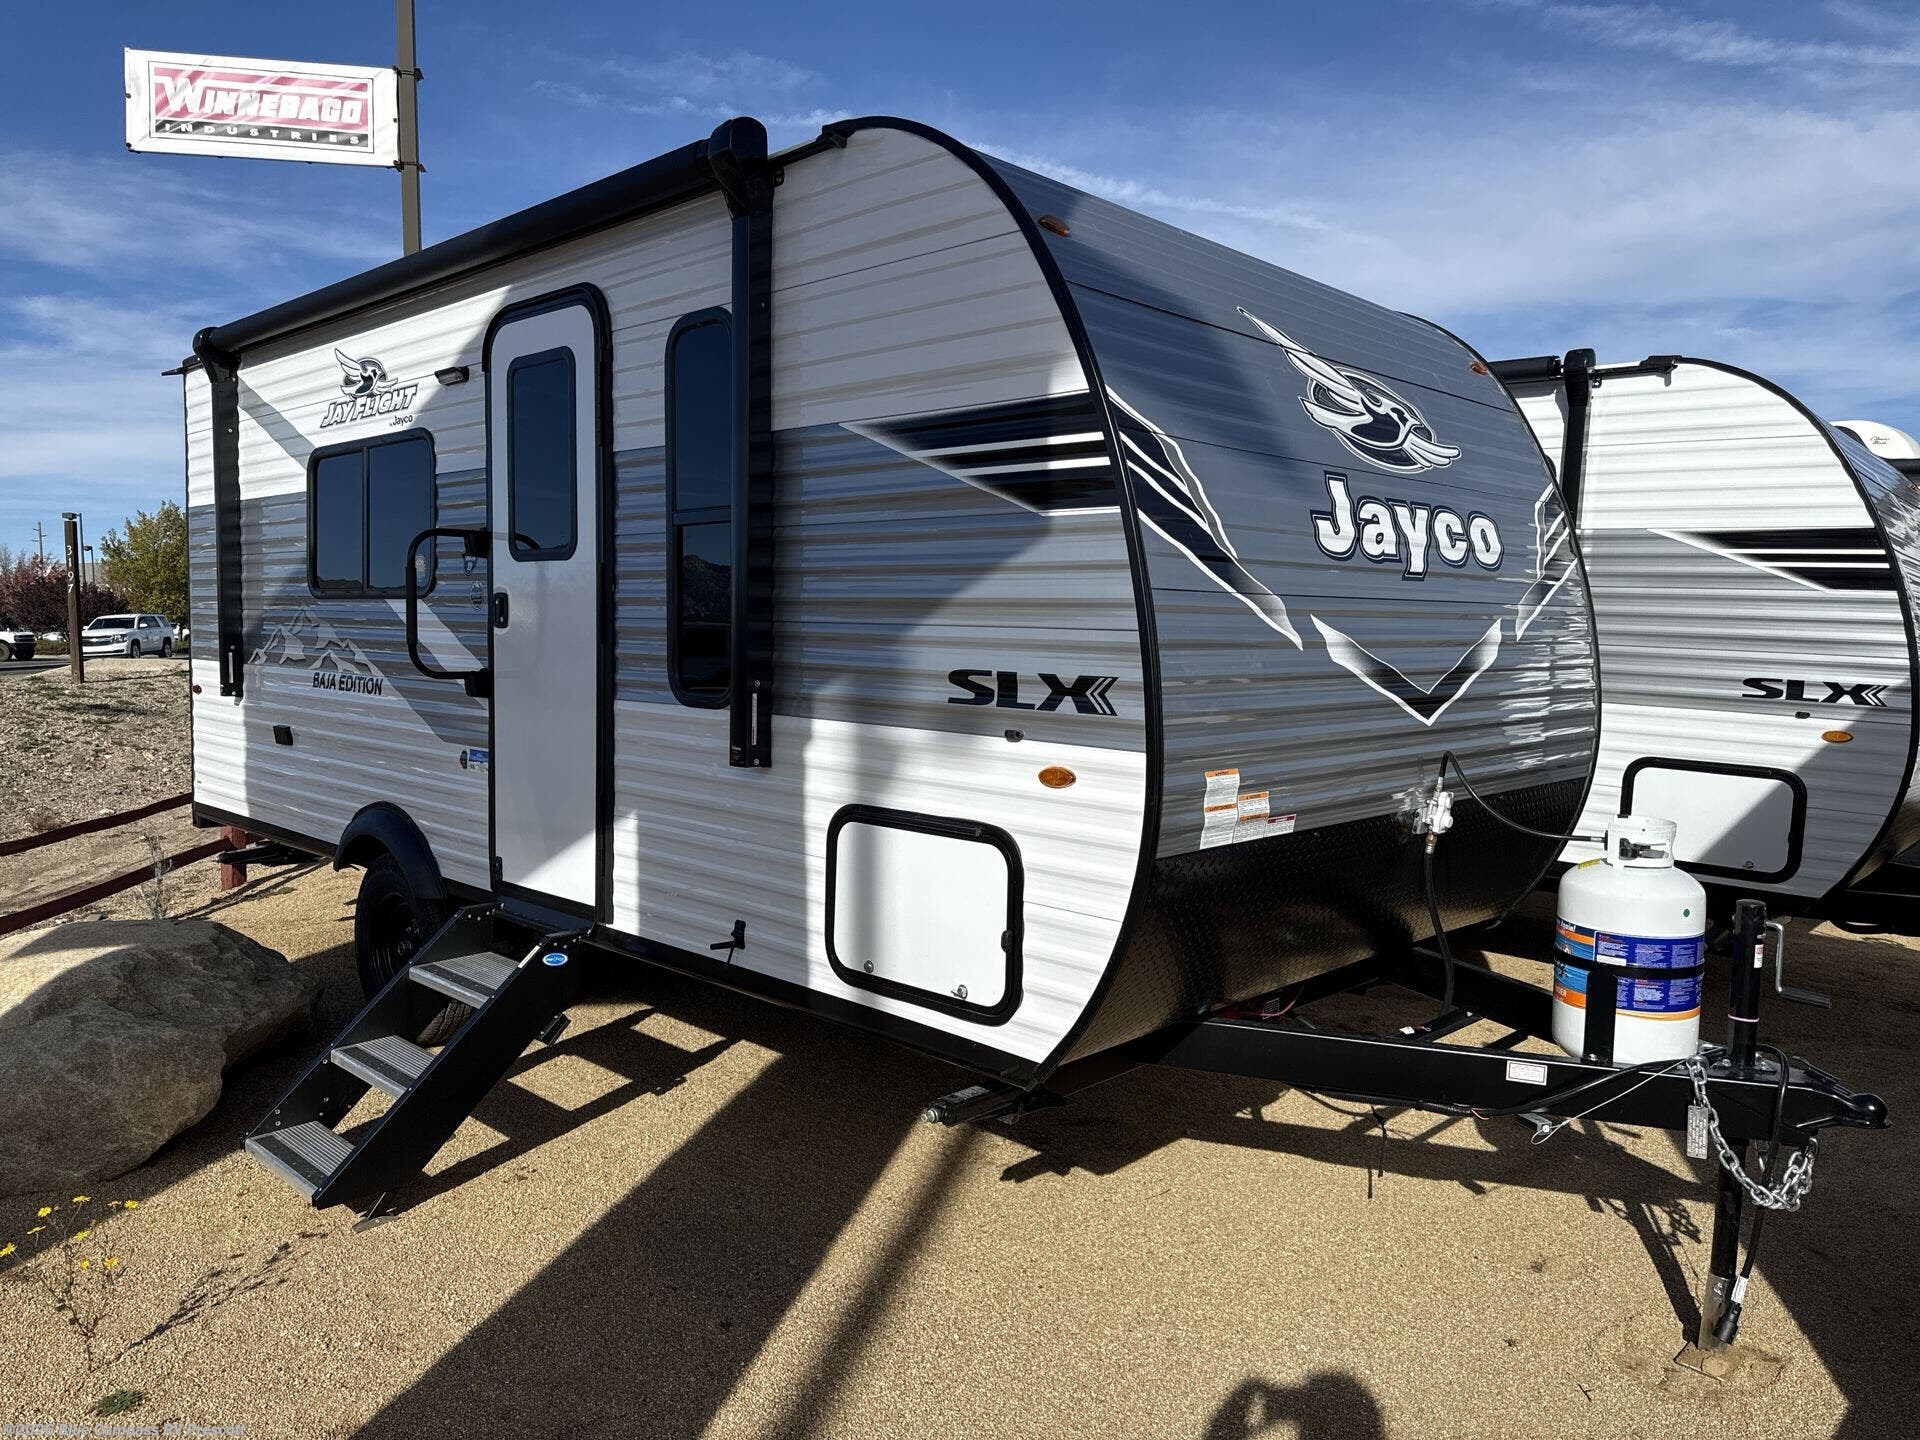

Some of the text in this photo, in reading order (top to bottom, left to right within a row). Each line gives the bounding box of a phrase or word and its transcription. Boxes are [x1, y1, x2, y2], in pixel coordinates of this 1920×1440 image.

[154, 75, 362, 124] WINNEBAGO
[164, 122, 361, 145] INDUSTRIES
[320, 383, 418, 428] JAY FLIGHT
[1310, 471, 1504, 581] Jayco
[66, 544, 74, 593] 3197
[313, 672, 383, 696] BAJA EDITION
[948, 669, 1119, 716] SLX
[1742, 677, 1890, 707] SLX
